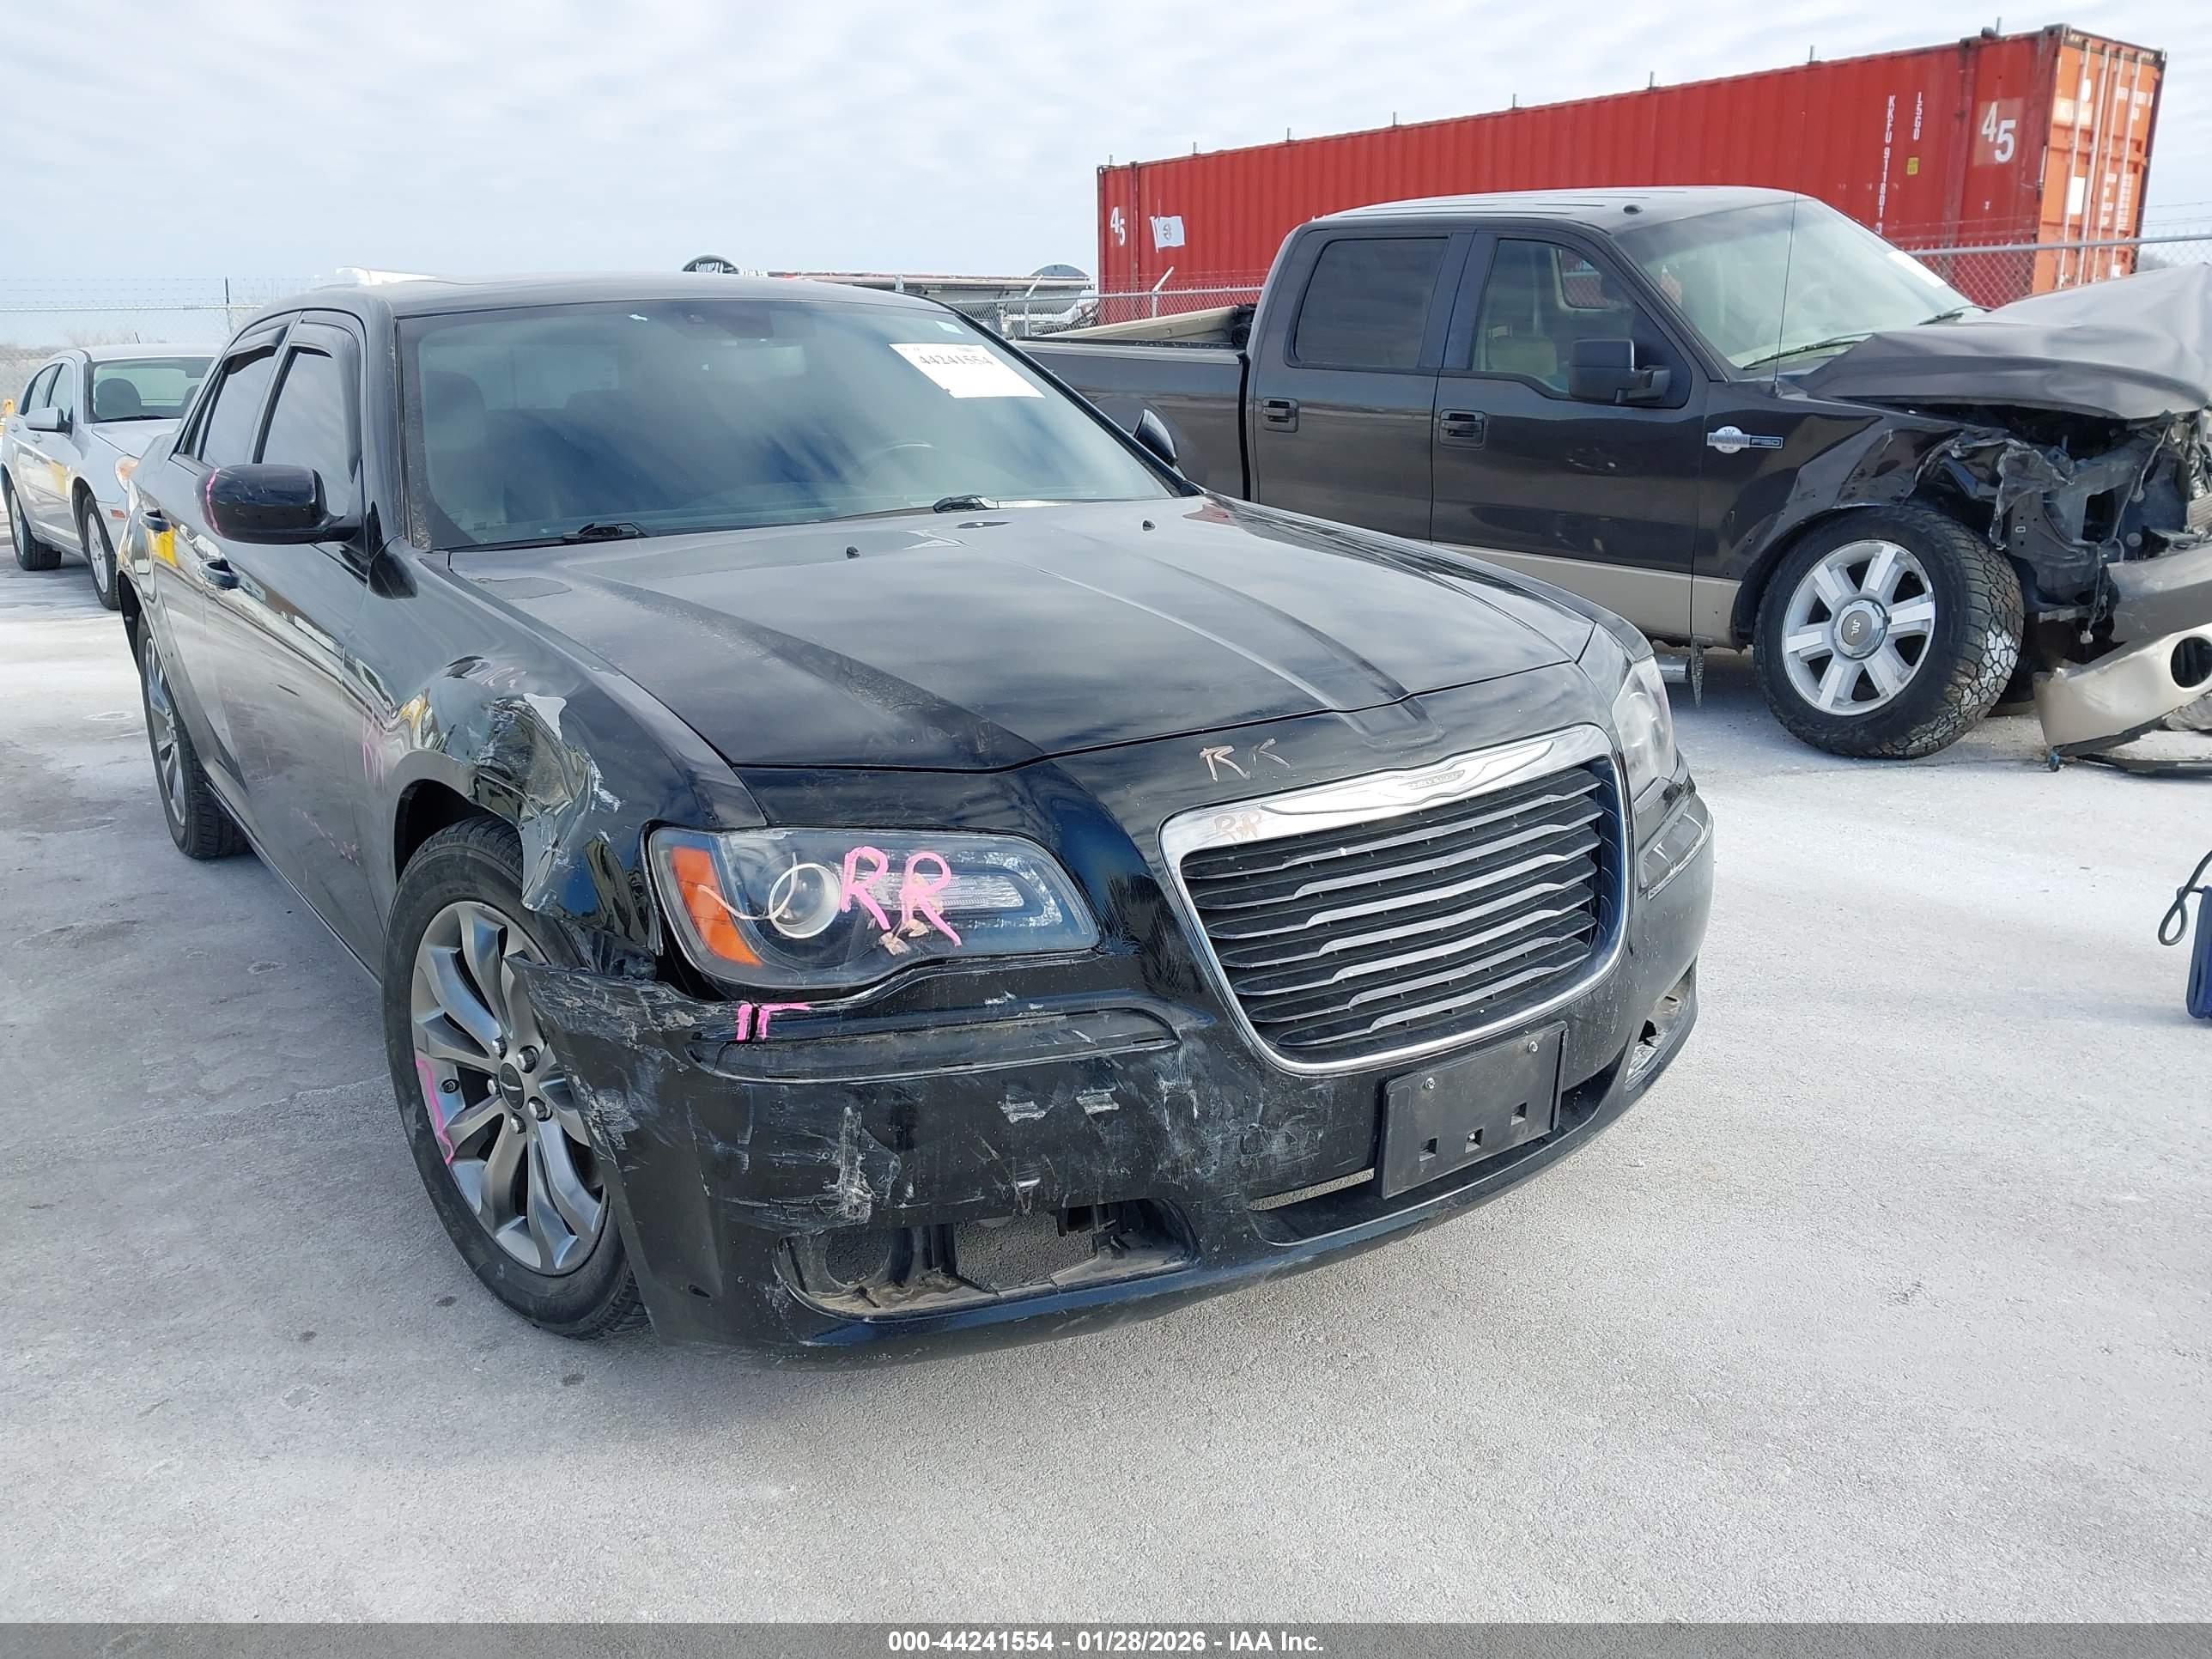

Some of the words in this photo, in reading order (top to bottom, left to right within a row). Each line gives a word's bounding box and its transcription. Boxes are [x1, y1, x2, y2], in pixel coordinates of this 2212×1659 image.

[1981, 100, 2017, 163] 45
[1109, 205, 1127, 246] 45
[919, 355, 994, 366] 44241554
